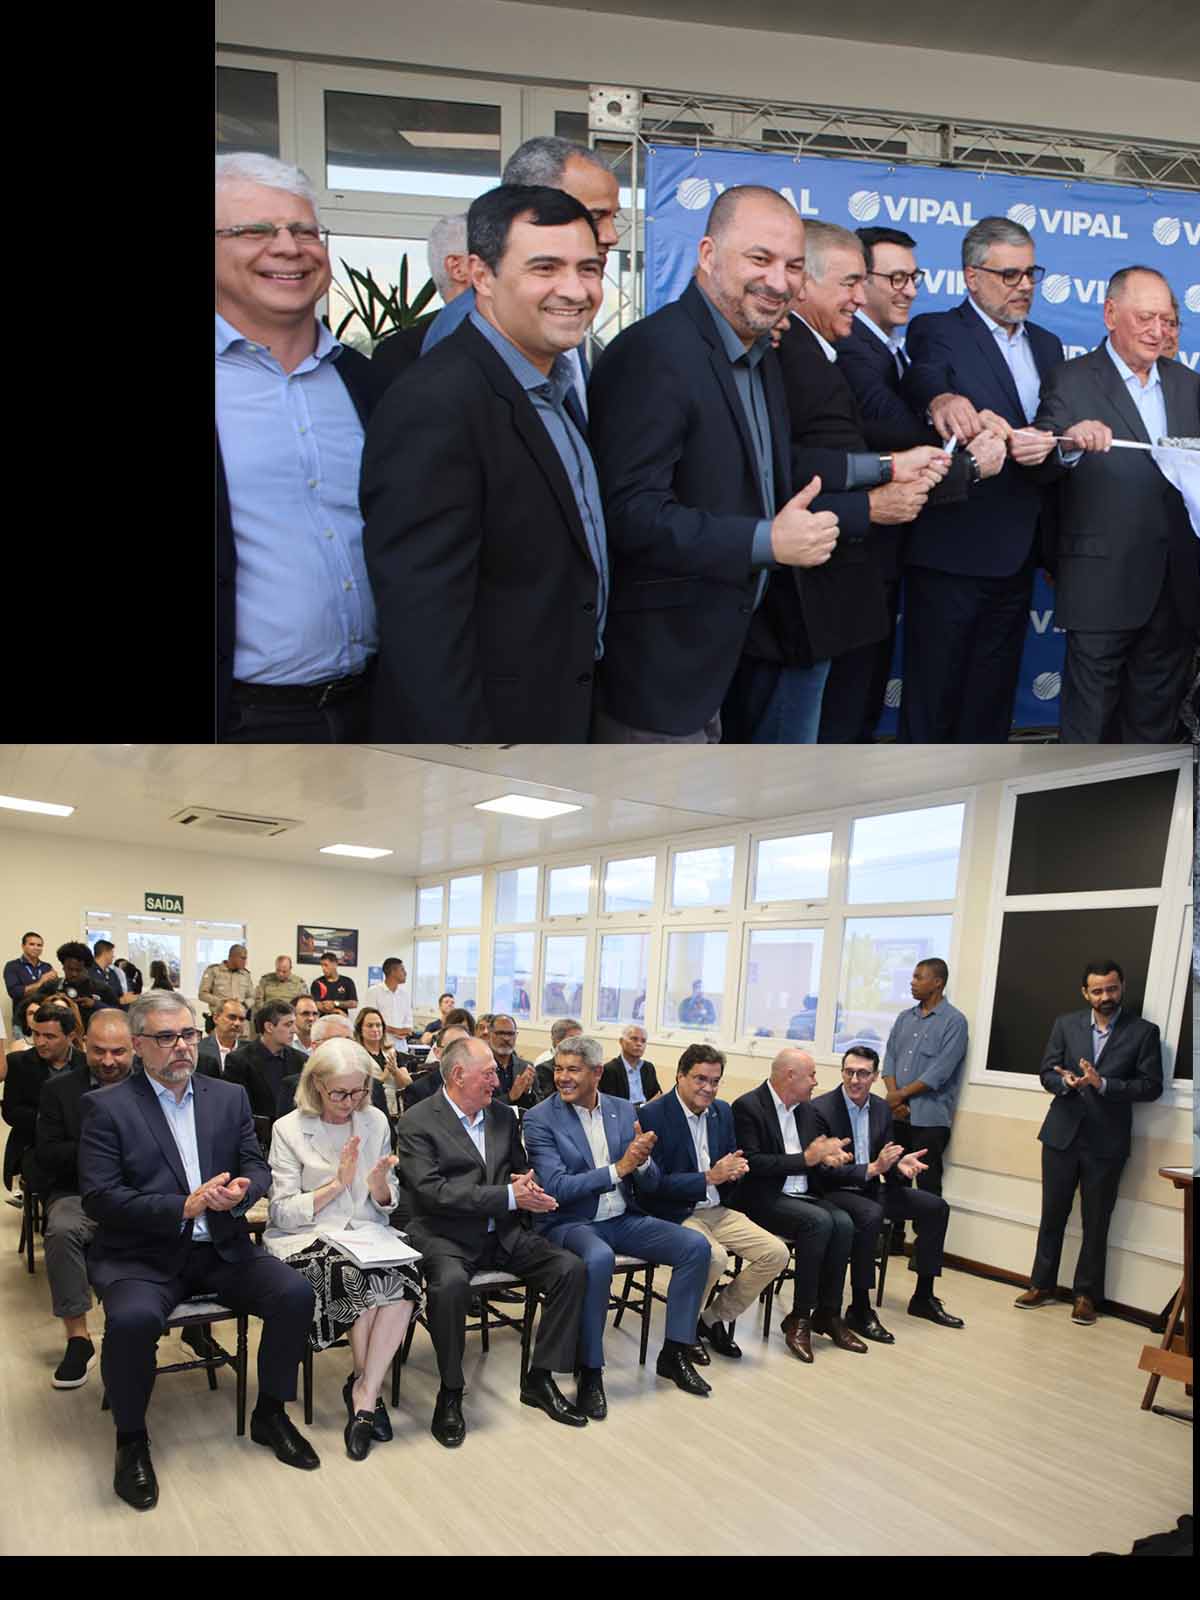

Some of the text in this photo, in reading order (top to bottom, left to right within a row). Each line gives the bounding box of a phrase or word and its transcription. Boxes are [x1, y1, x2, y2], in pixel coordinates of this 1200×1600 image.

[883, 195, 977, 227] VIPAL
[1039, 208, 1128, 240] VIPAL
[146, 896, 182, 911] SAÍDA
